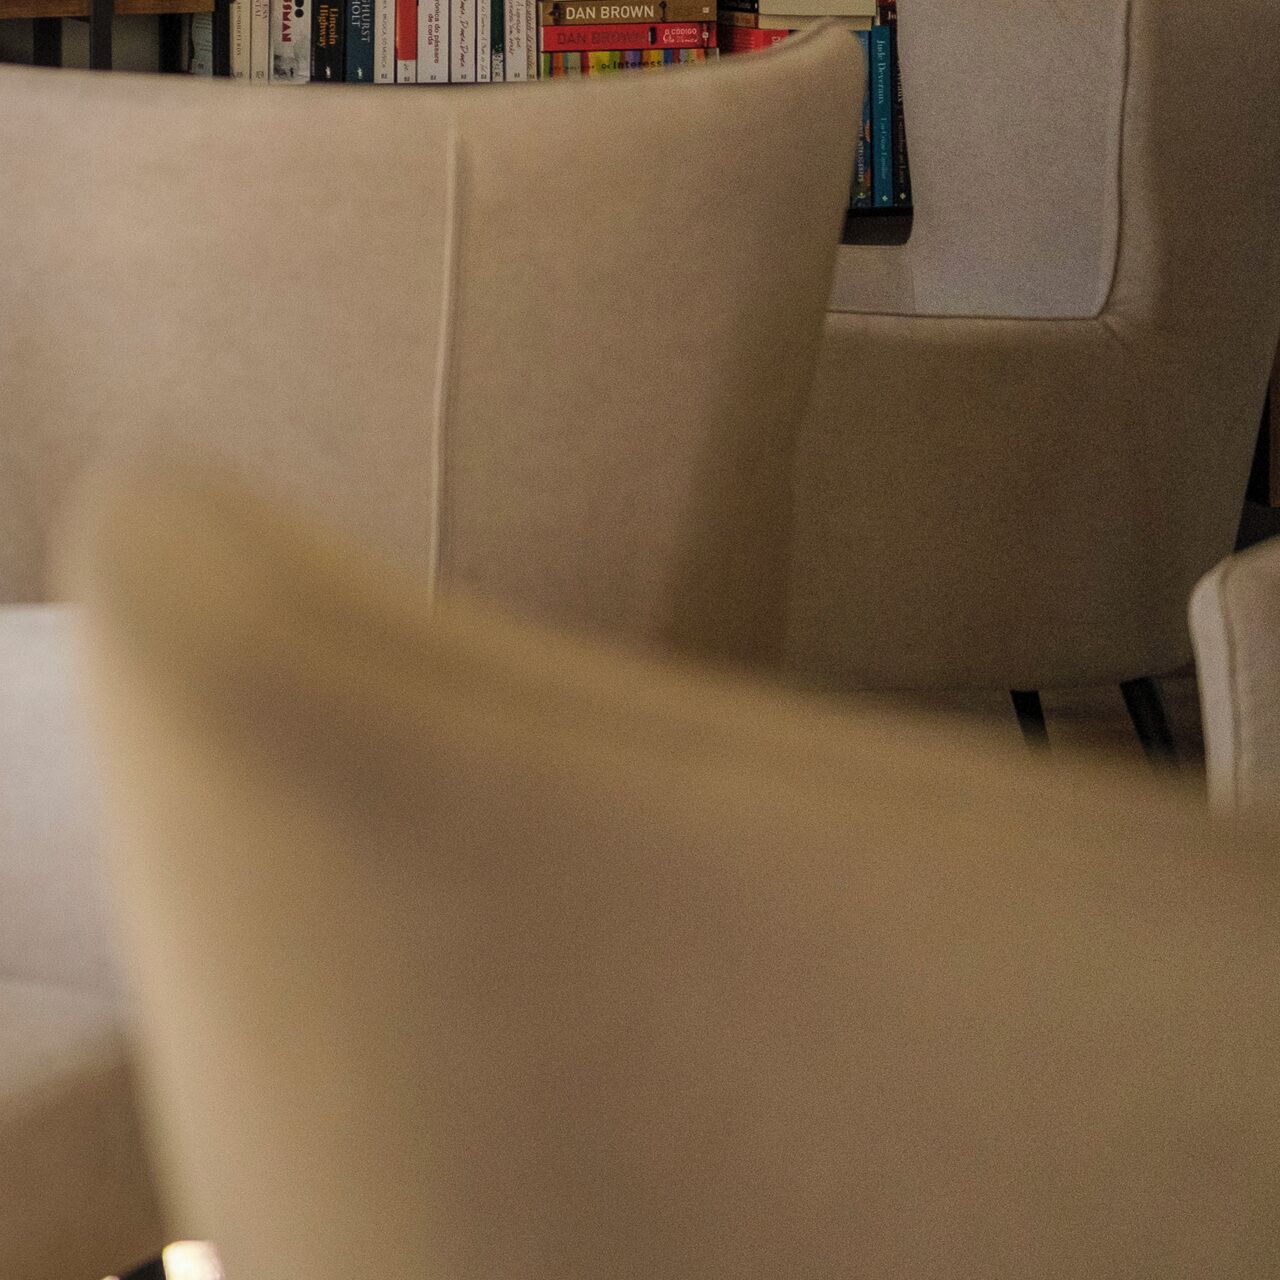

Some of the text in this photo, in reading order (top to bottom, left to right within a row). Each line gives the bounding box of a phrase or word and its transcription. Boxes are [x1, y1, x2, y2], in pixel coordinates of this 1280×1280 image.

[566, 7, 654, 18] DAN BROWN
[317, 5, 328, 48] Highway
